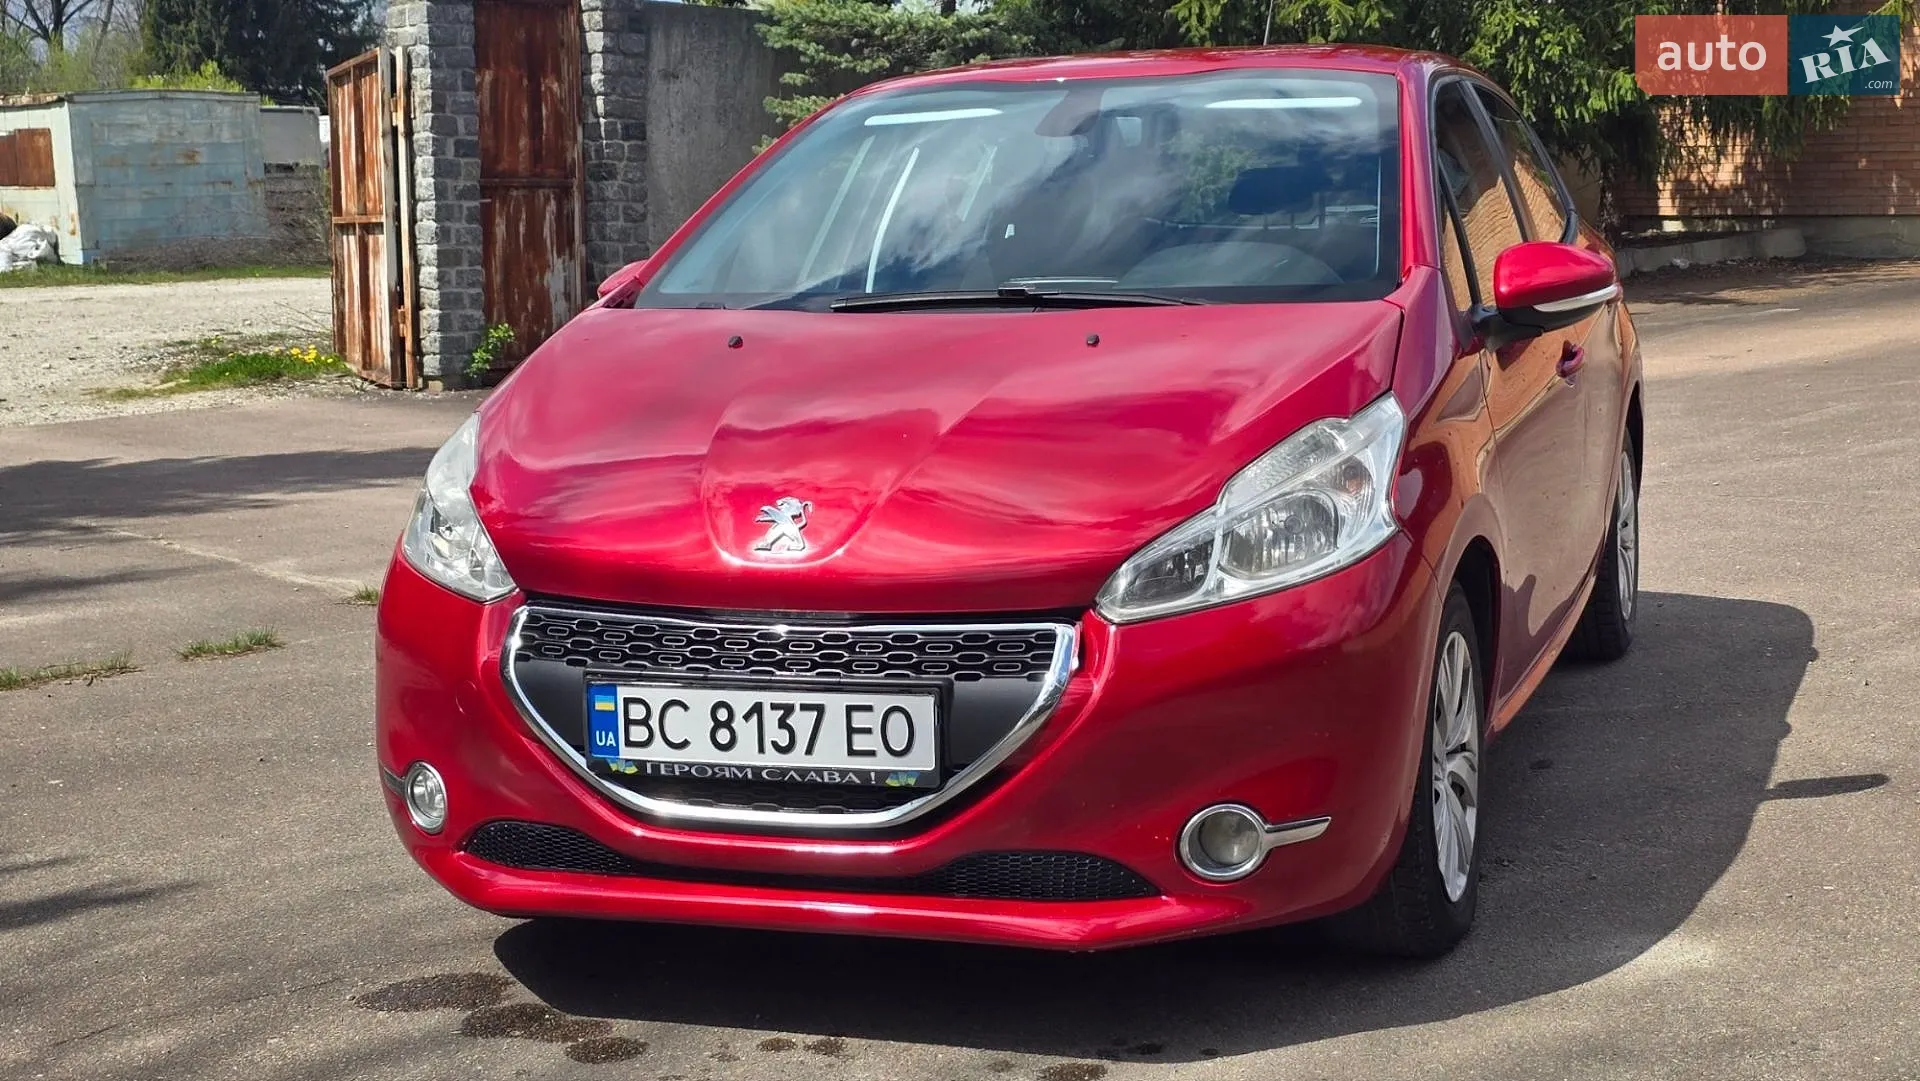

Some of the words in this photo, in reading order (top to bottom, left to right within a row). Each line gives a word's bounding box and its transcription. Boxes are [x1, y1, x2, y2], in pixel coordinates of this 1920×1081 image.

[622, 696, 692, 750] BC
[708, 700, 826, 756] 8137
[845, 704, 915, 757] EO
[595, 730, 617, 747] UA
[645, 761, 753, 780] ГЕРОЯМ
[762, 769, 860, 784] СЛАВА
